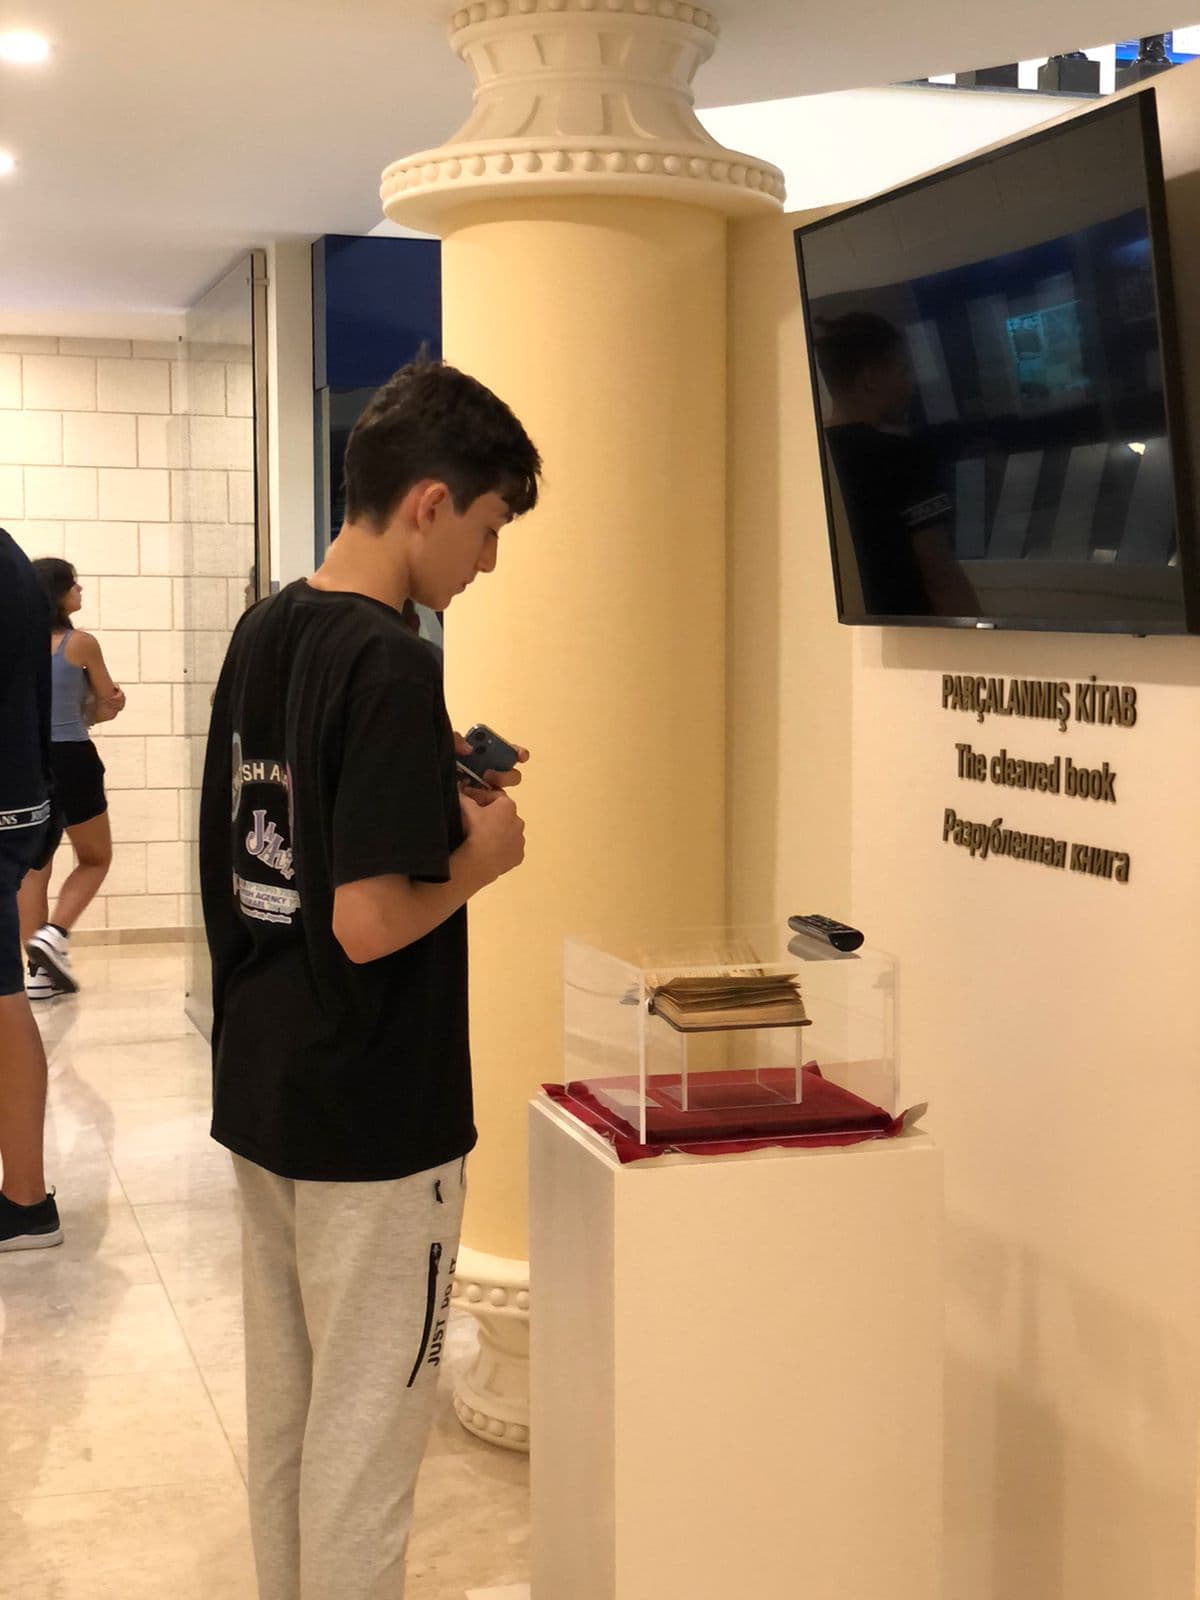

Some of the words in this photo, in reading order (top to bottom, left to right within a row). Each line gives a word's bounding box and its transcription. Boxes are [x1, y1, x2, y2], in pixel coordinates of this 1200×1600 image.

[942, 674, 1071, 732] PARÇALANMIŞ
[1074, 675, 1138, 728] KİTAB
[955, 743, 988, 782] The
[990, 749, 1061, 794] cleaved
[1064, 757, 1117, 804] book
[942, 808, 1067, 869] Разрубленная
[1070, 842, 1131, 883] книга
[428, 1319, 446, 1367] JUST
[441, 1283, 453, 1310] DO
